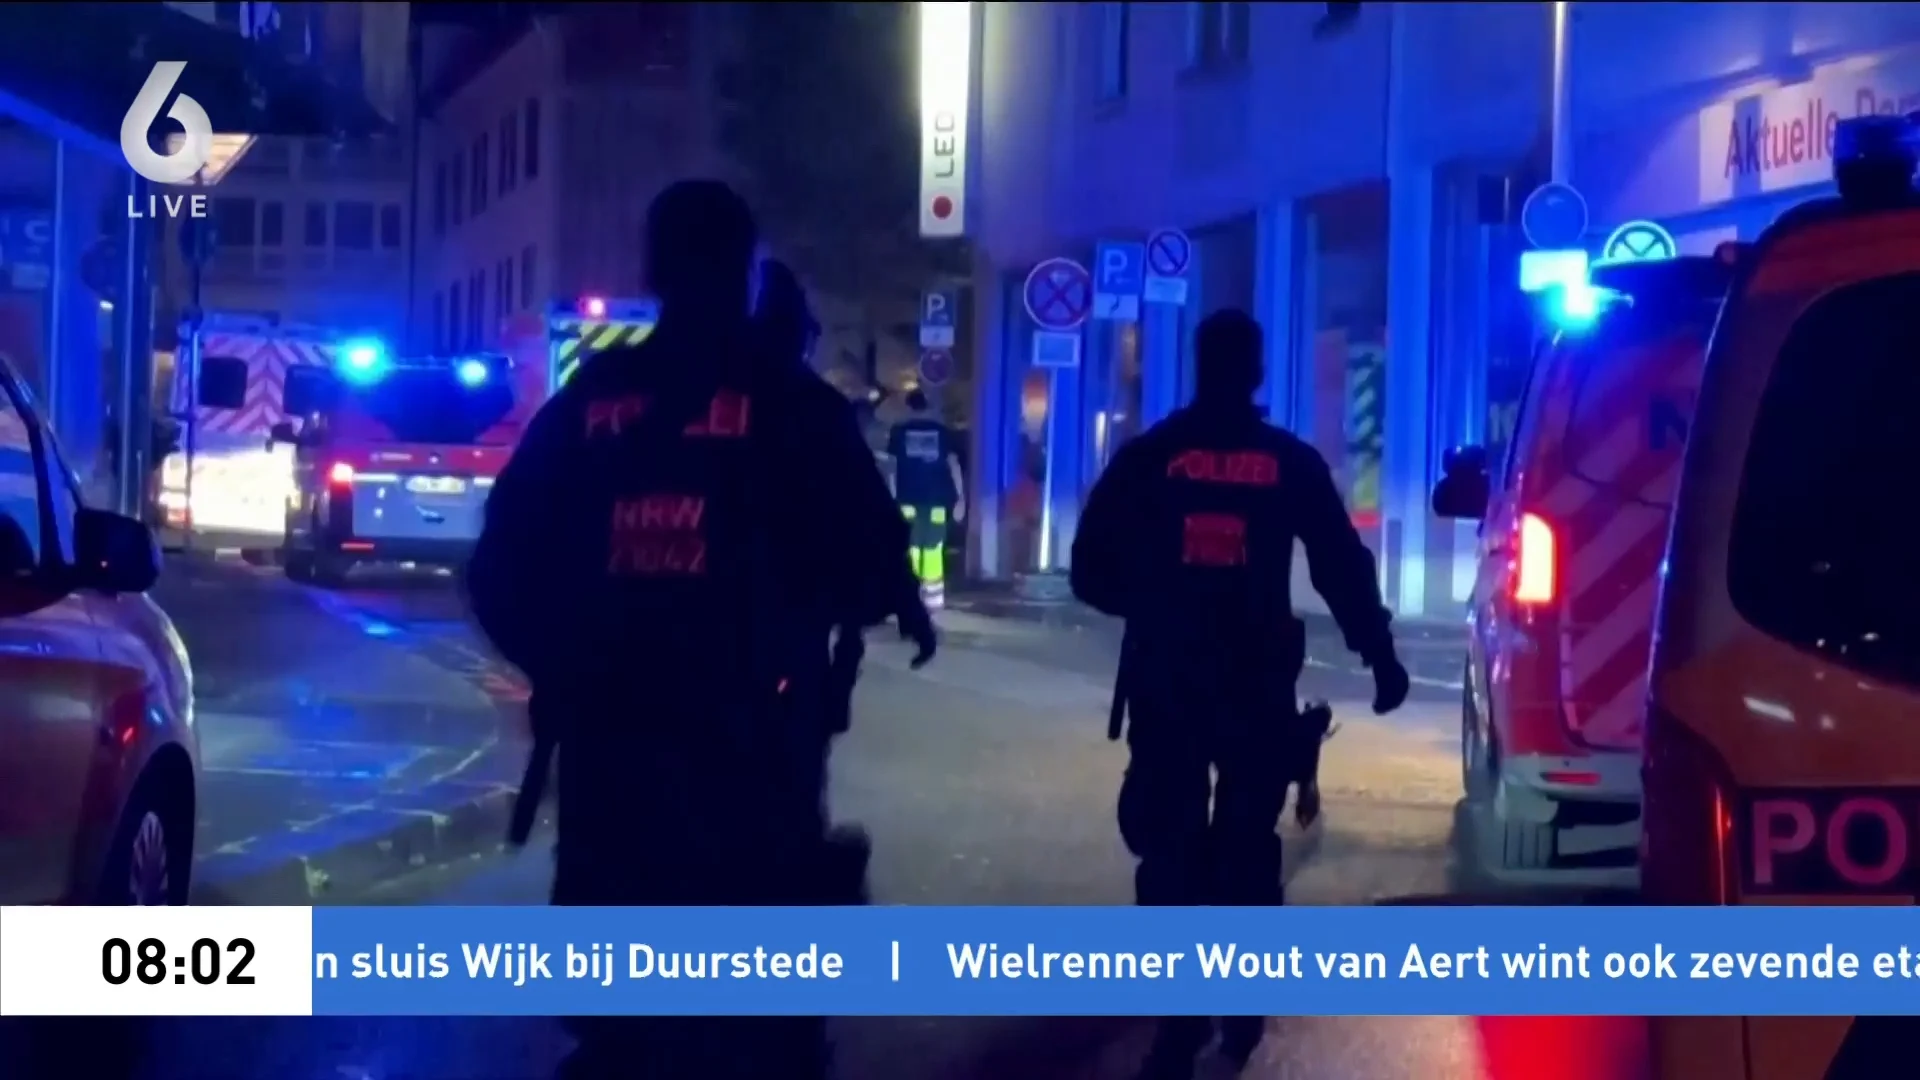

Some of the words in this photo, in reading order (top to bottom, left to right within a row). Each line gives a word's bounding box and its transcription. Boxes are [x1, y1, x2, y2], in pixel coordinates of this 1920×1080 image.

[934, 111, 955, 177] LED
[1724, 97, 1840, 178] Aktuelle
[1167, 450, 1278, 484] POLIZEI
[613, 495, 707, 530] NRW
